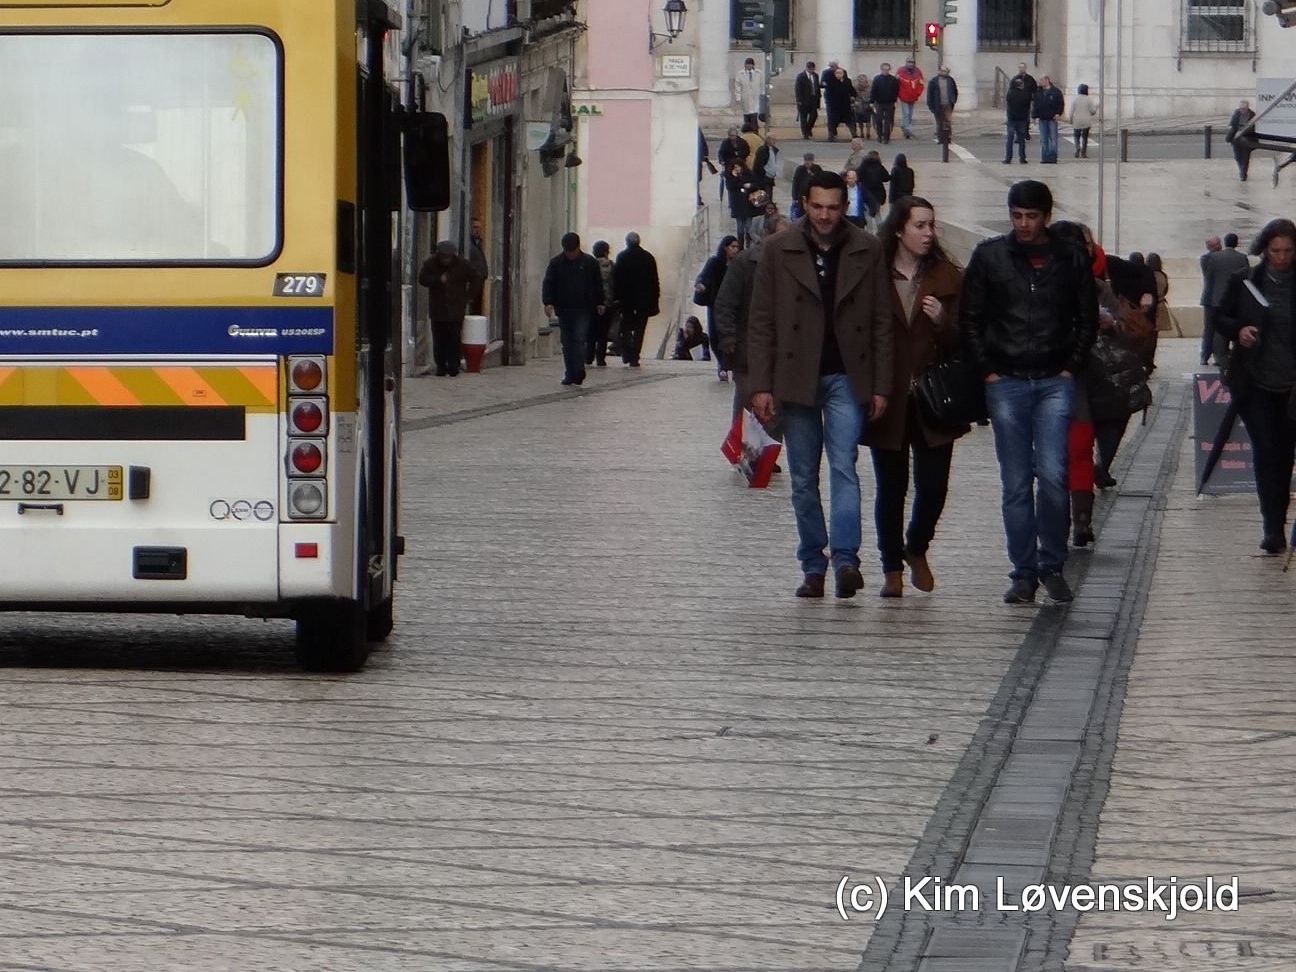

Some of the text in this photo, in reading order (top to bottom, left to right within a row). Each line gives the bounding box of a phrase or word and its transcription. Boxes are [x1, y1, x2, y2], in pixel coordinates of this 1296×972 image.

[282, 276, 317, 293] 279
[108, 470, 119, 479] 03
[108, 486, 119, 496] 08
